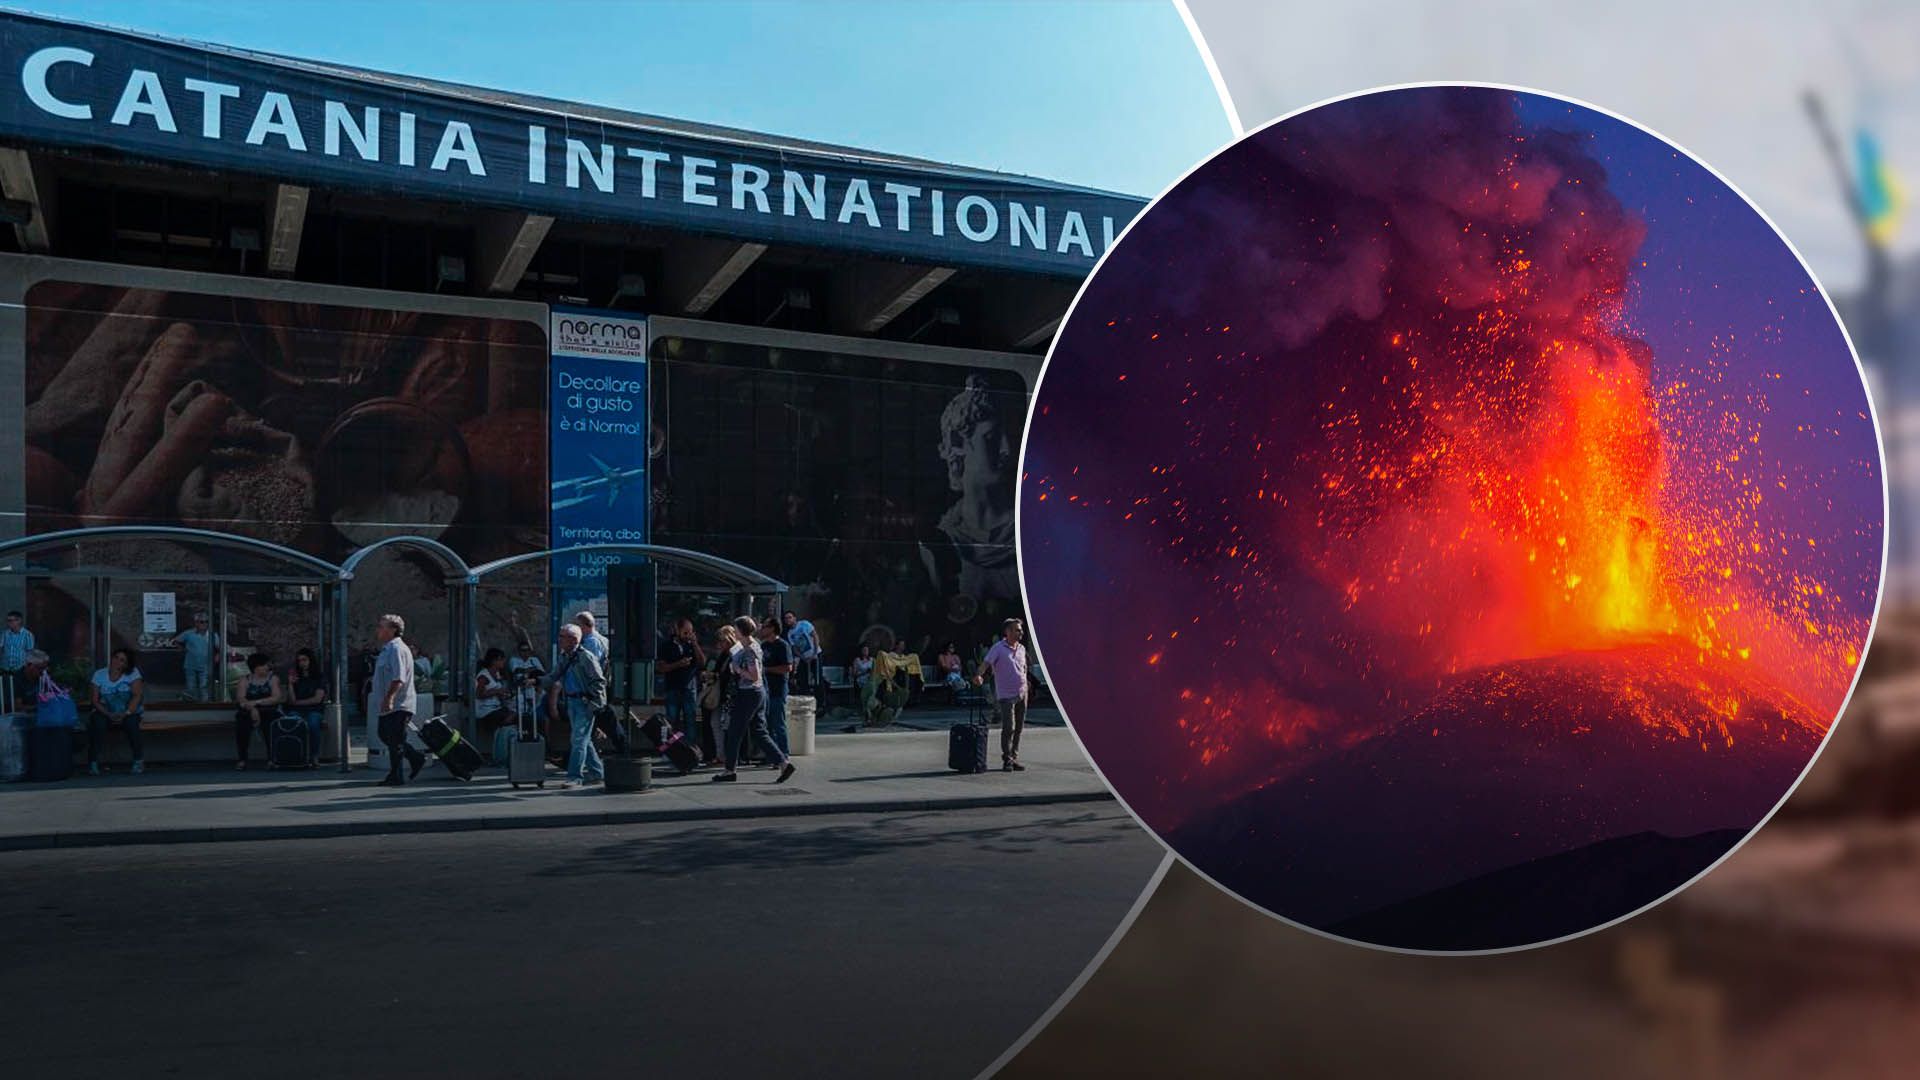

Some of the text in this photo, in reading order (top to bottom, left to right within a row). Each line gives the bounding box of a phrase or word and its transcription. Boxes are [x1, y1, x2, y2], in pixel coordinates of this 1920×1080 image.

[22, 47, 487, 176] CATANIA
[560, 319, 641, 340] norma
[559, 372, 641, 394] Decollare
[567, 393, 633, 414] di gusto
[560, 415, 640, 435] è di Norma!
[559, 526, 641, 541] Territorio, cibo
